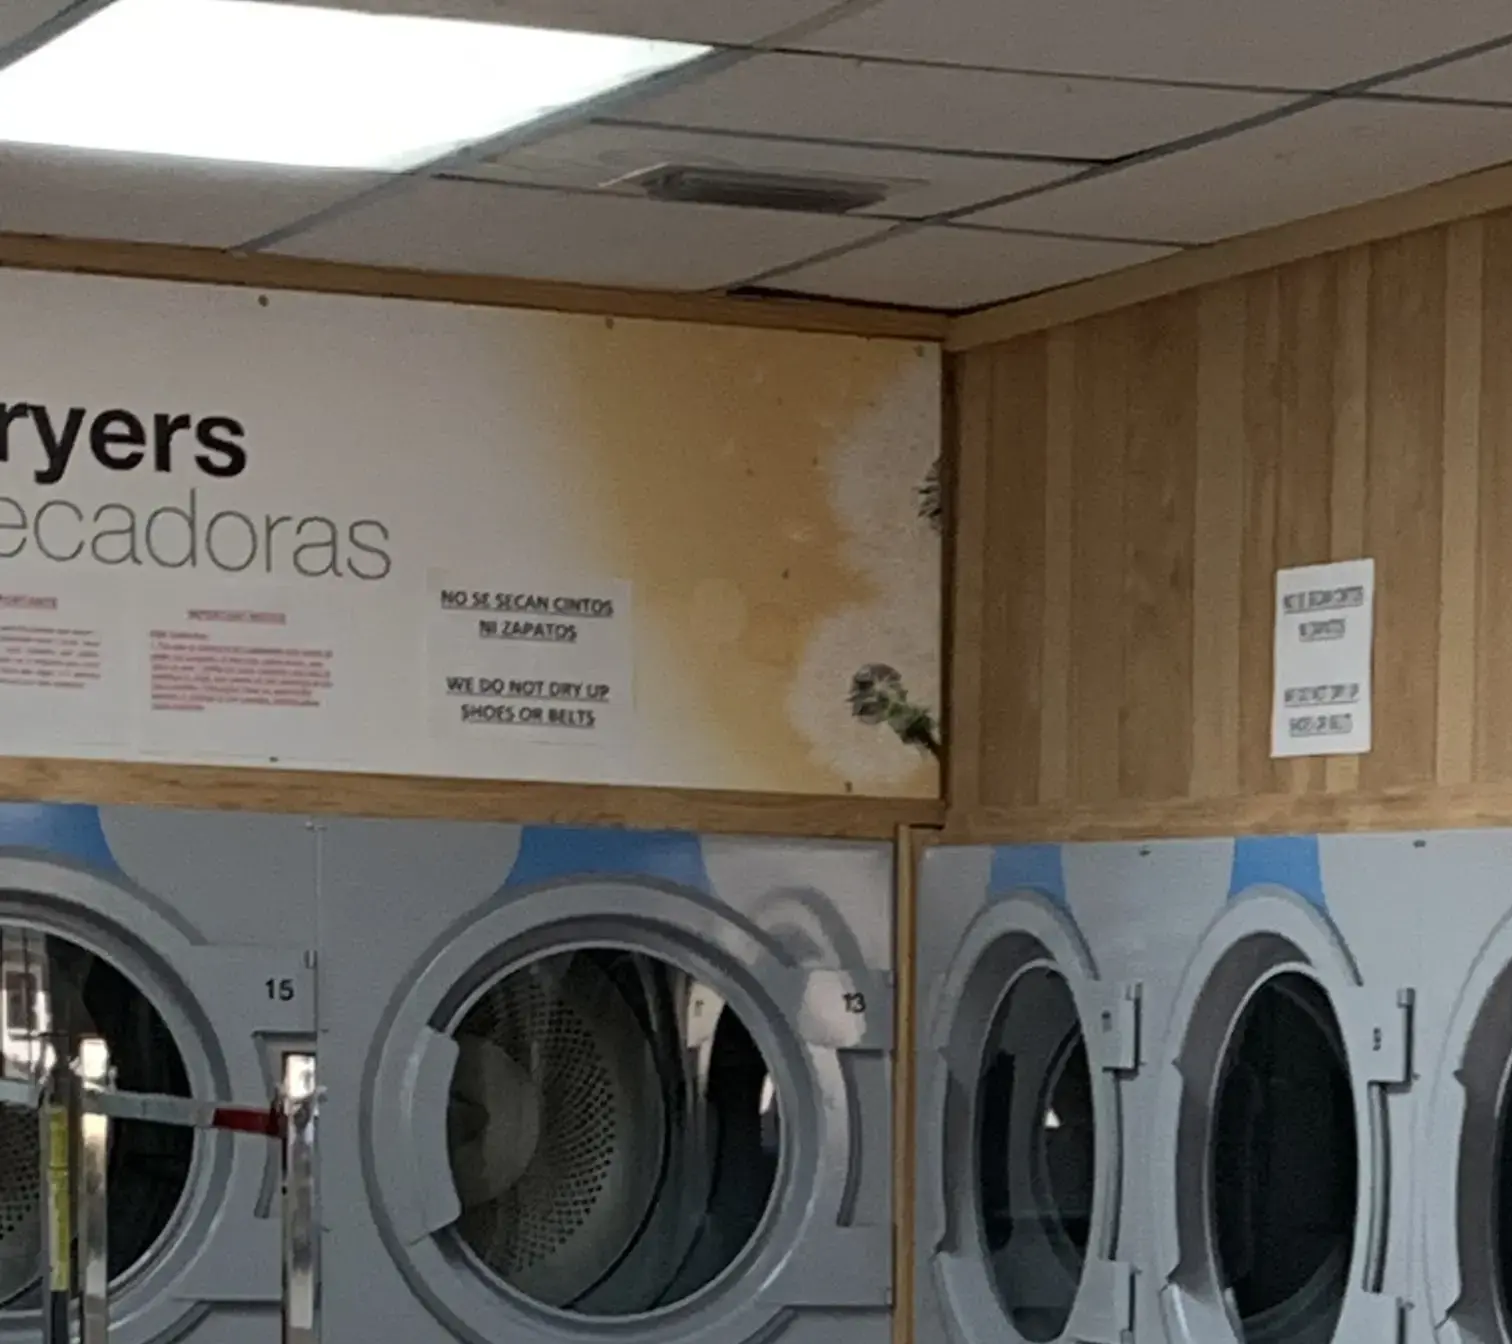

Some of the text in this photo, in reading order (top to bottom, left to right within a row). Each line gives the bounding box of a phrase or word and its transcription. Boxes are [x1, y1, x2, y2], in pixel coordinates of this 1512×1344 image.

[440, 589, 615, 617] NO SE SECAN CINTOS
[479, 619, 578, 642] NI ZAPATOS
[446, 676, 611, 700] WE DO NOT DRY UP
[461, 703, 597, 728] SHOES OR BELTS
[265, 977, 294, 1001] 15
[842, 991, 867, 1014] 13
